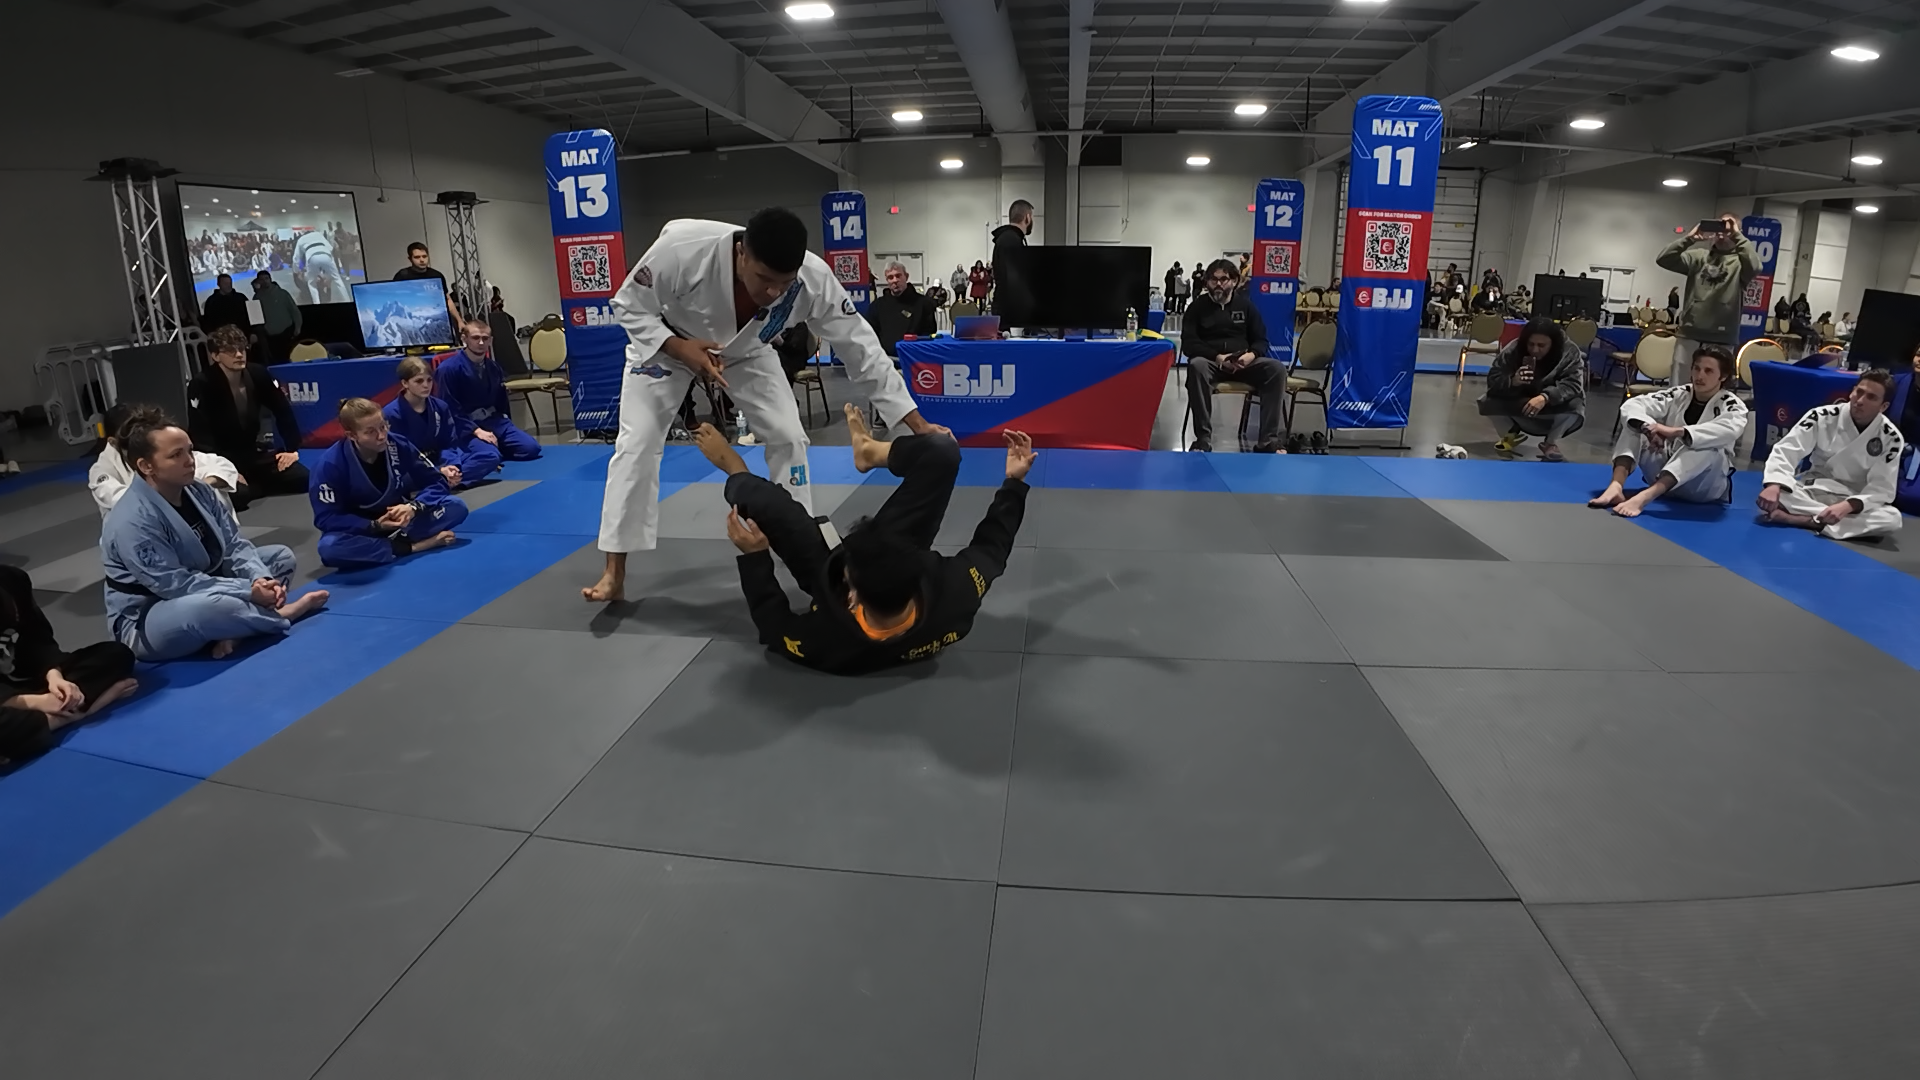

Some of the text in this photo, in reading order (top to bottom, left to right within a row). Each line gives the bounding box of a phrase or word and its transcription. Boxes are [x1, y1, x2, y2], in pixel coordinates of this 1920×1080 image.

[1372, 119, 1419, 137] MAT
[561, 148, 599, 167] MAT
[1373, 145, 1415, 186] 11
[558, 174, 609, 219] 13
[1270, 191, 1296, 201] MAT
[833, 201, 856, 211] MAT
[1264, 204, 1293, 227] 12
[830, 215, 863, 240] 14
[1748, 227, 1771, 237] MAT
[847, 290, 865, 302] JJ
[1270, 282, 1293, 294] BJJ
[1372, 287, 1413, 310] BJJ
[1741, 314, 1762, 327] BJJ
[943, 364, 1015, 397] BJJ
[288, 381, 319, 402] BJJ
